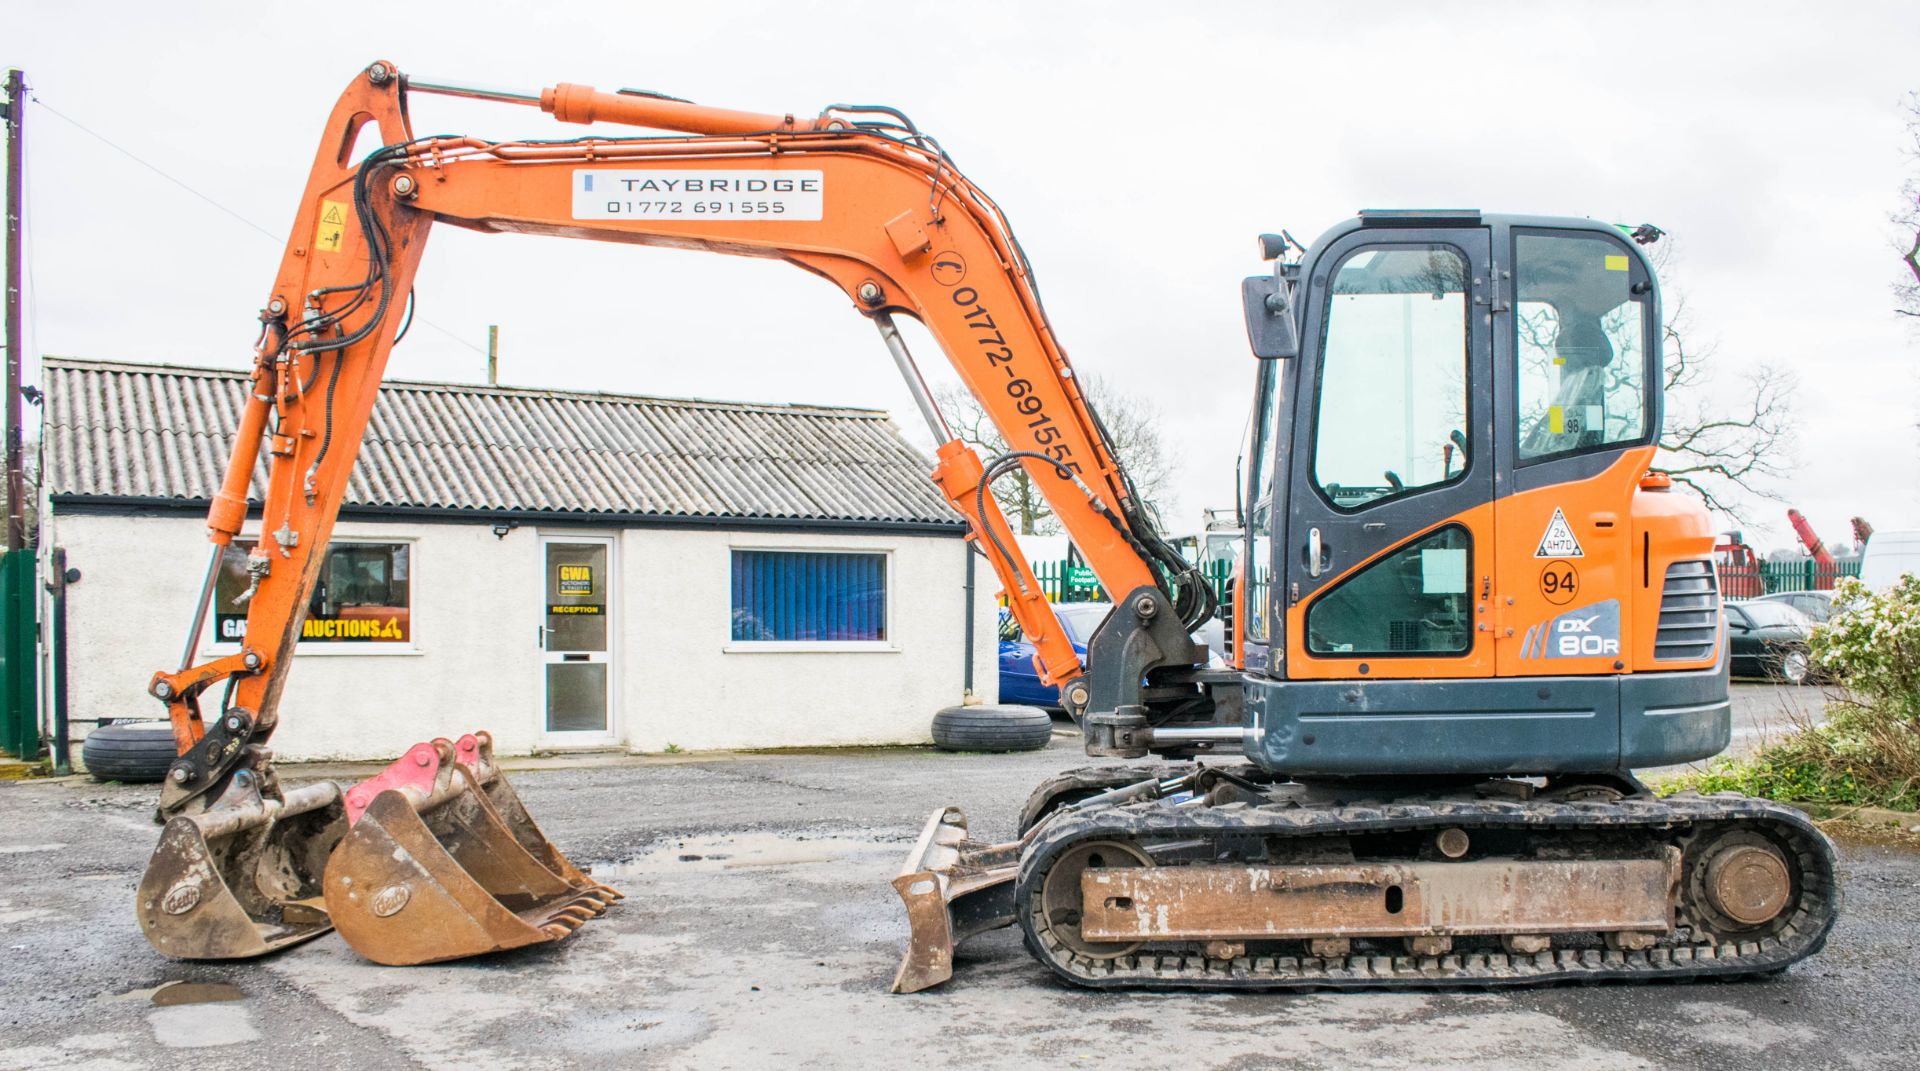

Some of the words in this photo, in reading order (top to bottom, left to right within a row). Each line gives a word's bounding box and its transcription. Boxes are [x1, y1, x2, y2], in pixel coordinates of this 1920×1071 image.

[620, 179, 819, 192] TAYBRIDGE
[607, 201, 682, 213] 01772
[693, 201, 785, 213] 691555
[952, 286, 1083, 481] 01772-691555
[560, 566, 590, 580] GWA
[1070, 576, 1097, 585] Footpath
[1543, 571, 1575, 594] 94
[222, 619, 249, 637] GA
[303, 619, 381, 637] AUCTIONS
[1558, 615, 1600, 632] DX
[1559, 635, 1620, 656] 80R
